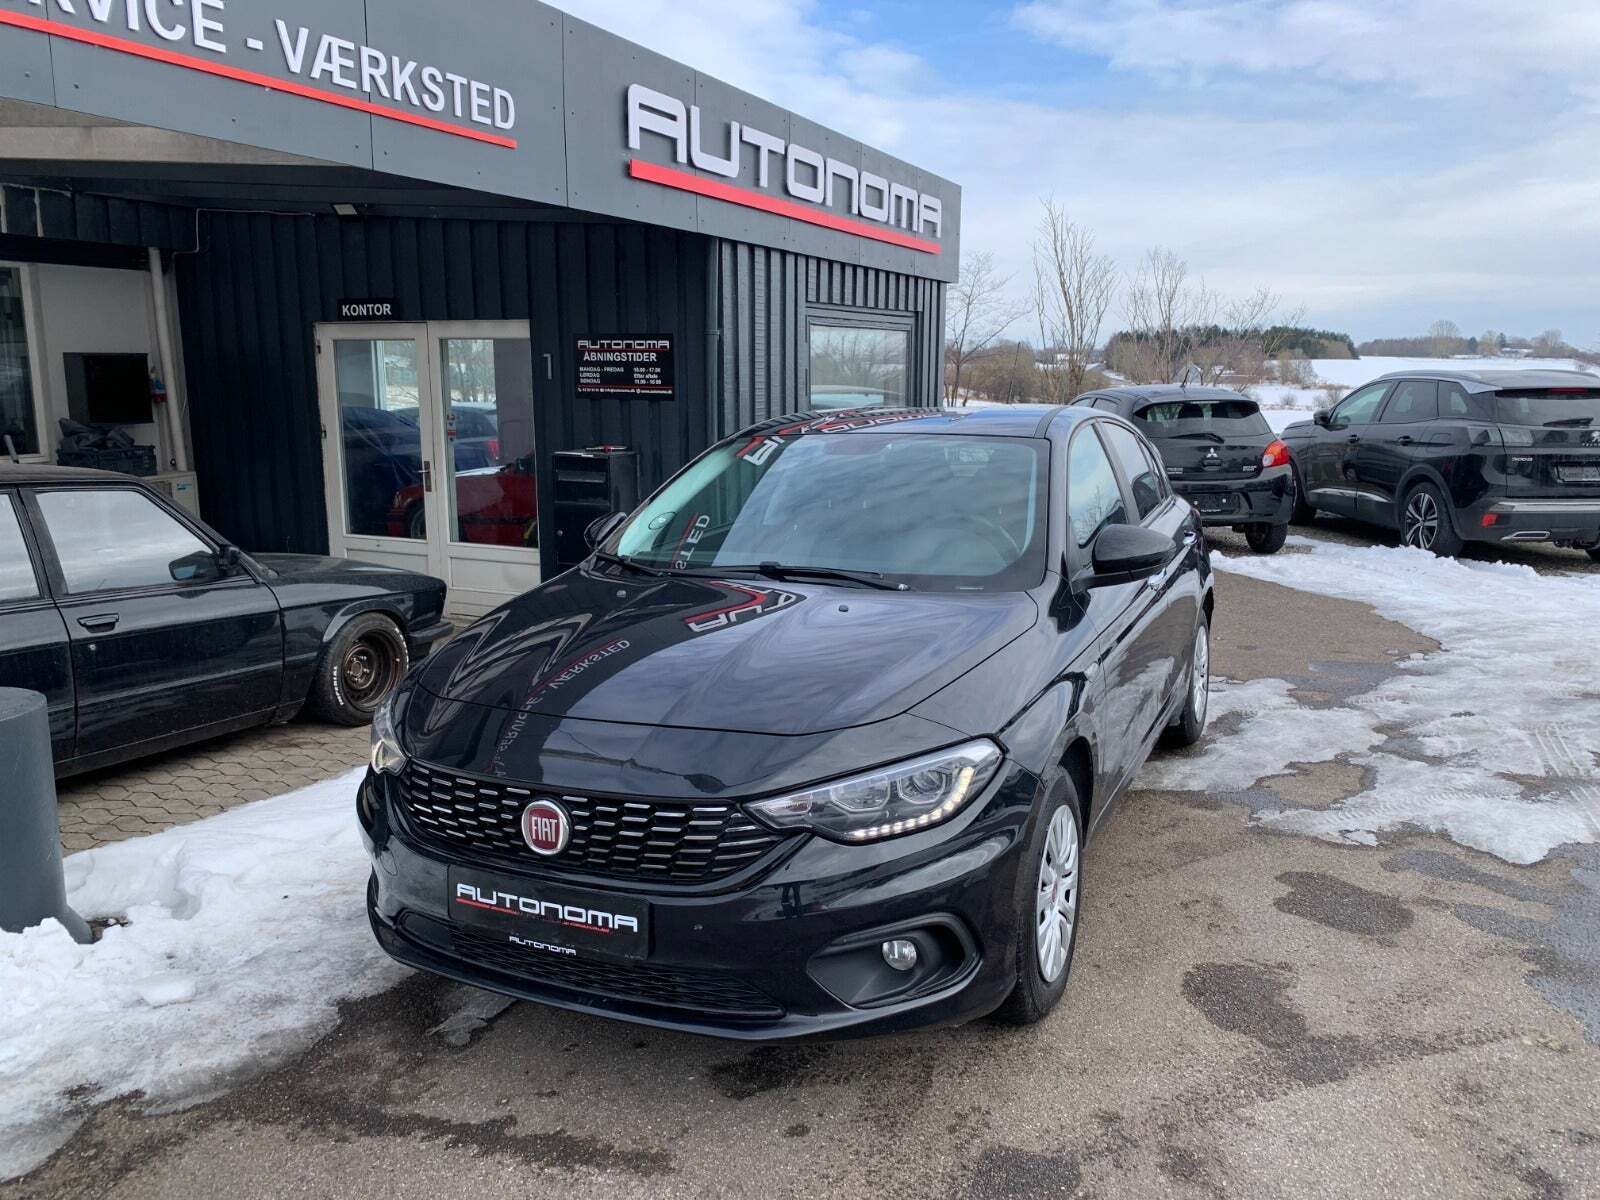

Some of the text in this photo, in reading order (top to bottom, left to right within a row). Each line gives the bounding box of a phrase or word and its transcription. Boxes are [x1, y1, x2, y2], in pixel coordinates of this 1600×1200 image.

[28, 0, 227, 53] ICE
[275, 18, 517, 131] VÆRKSTED
[627, 83, 942, 239] AUTONOMA
[341, 303, 392, 317] KONTOR
[577, 340, 670, 350] AUTONOMA
[583, 350, 657, 362] ÅBNINGSTIDER
[531, 815, 558, 842] FIAT
[456, 883, 639, 933] AUTONOMA
[508, 935, 577, 956] AUTONOMA
